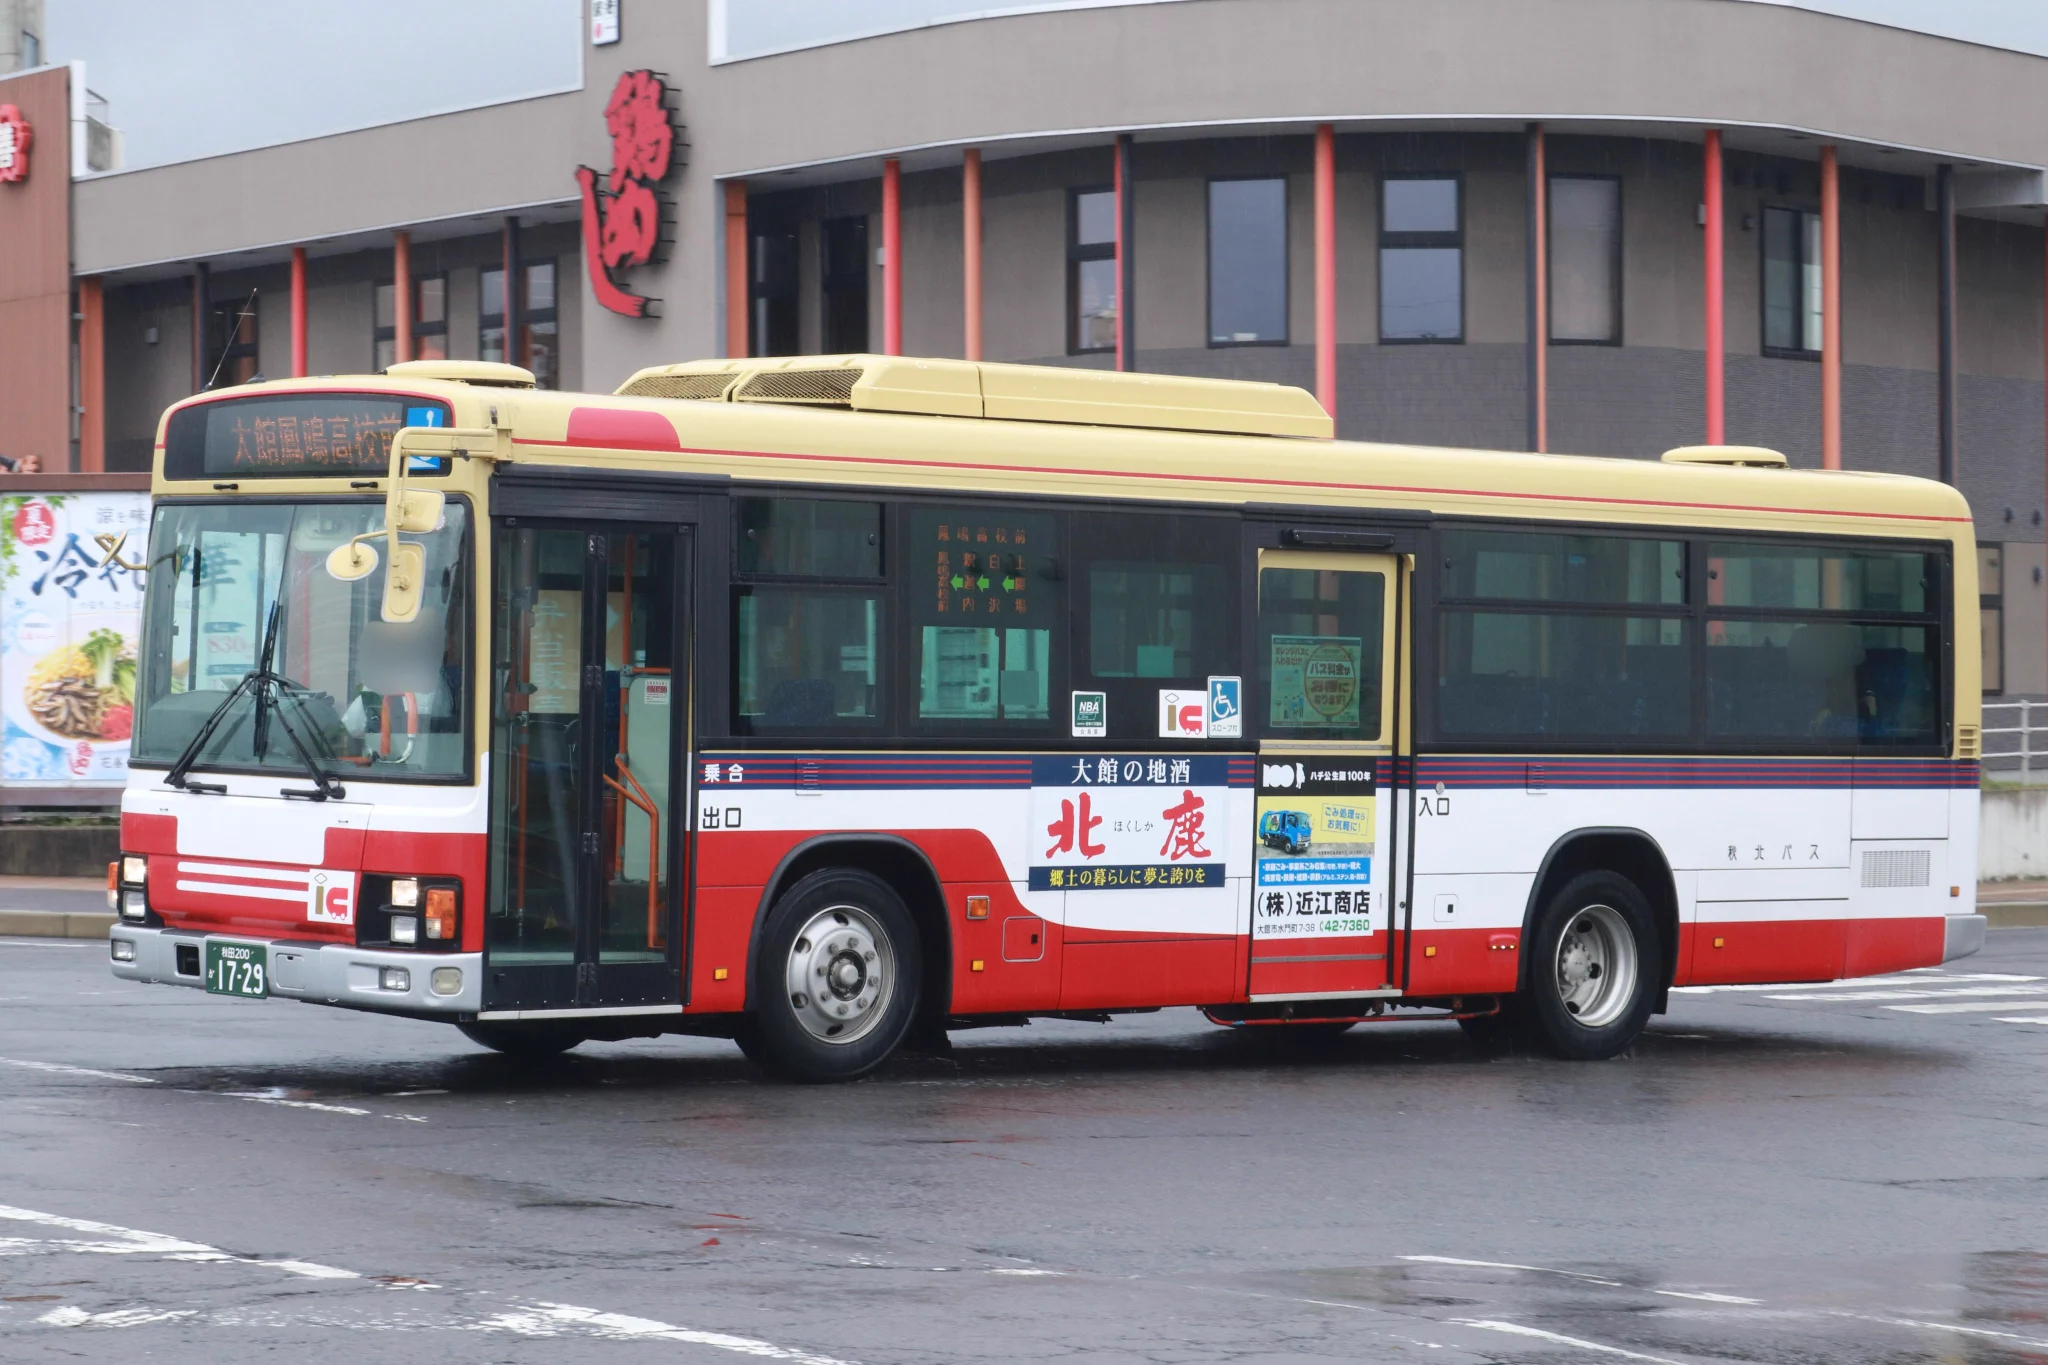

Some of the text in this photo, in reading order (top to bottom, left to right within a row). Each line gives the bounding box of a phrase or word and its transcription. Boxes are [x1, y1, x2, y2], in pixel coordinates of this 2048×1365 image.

[1079, 701, 1099, 712] NBA
[1211, 724, 1238, 732] スロープ付
[704, 763, 744, 783] 乗合
[1071, 758, 1191, 784] 大館の地酒
[1419, 797, 1450, 817] 入口
[702, 806, 742, 829] 出口
[1114, 820, 1154, 832] ほくしか
[1727, 844, 1820, 861] 秋北バス
[1049, 867, 1206, 887] 郷土の暮らしに夢と誇りを
[1325, 919, 1371, 932] 42-7360
